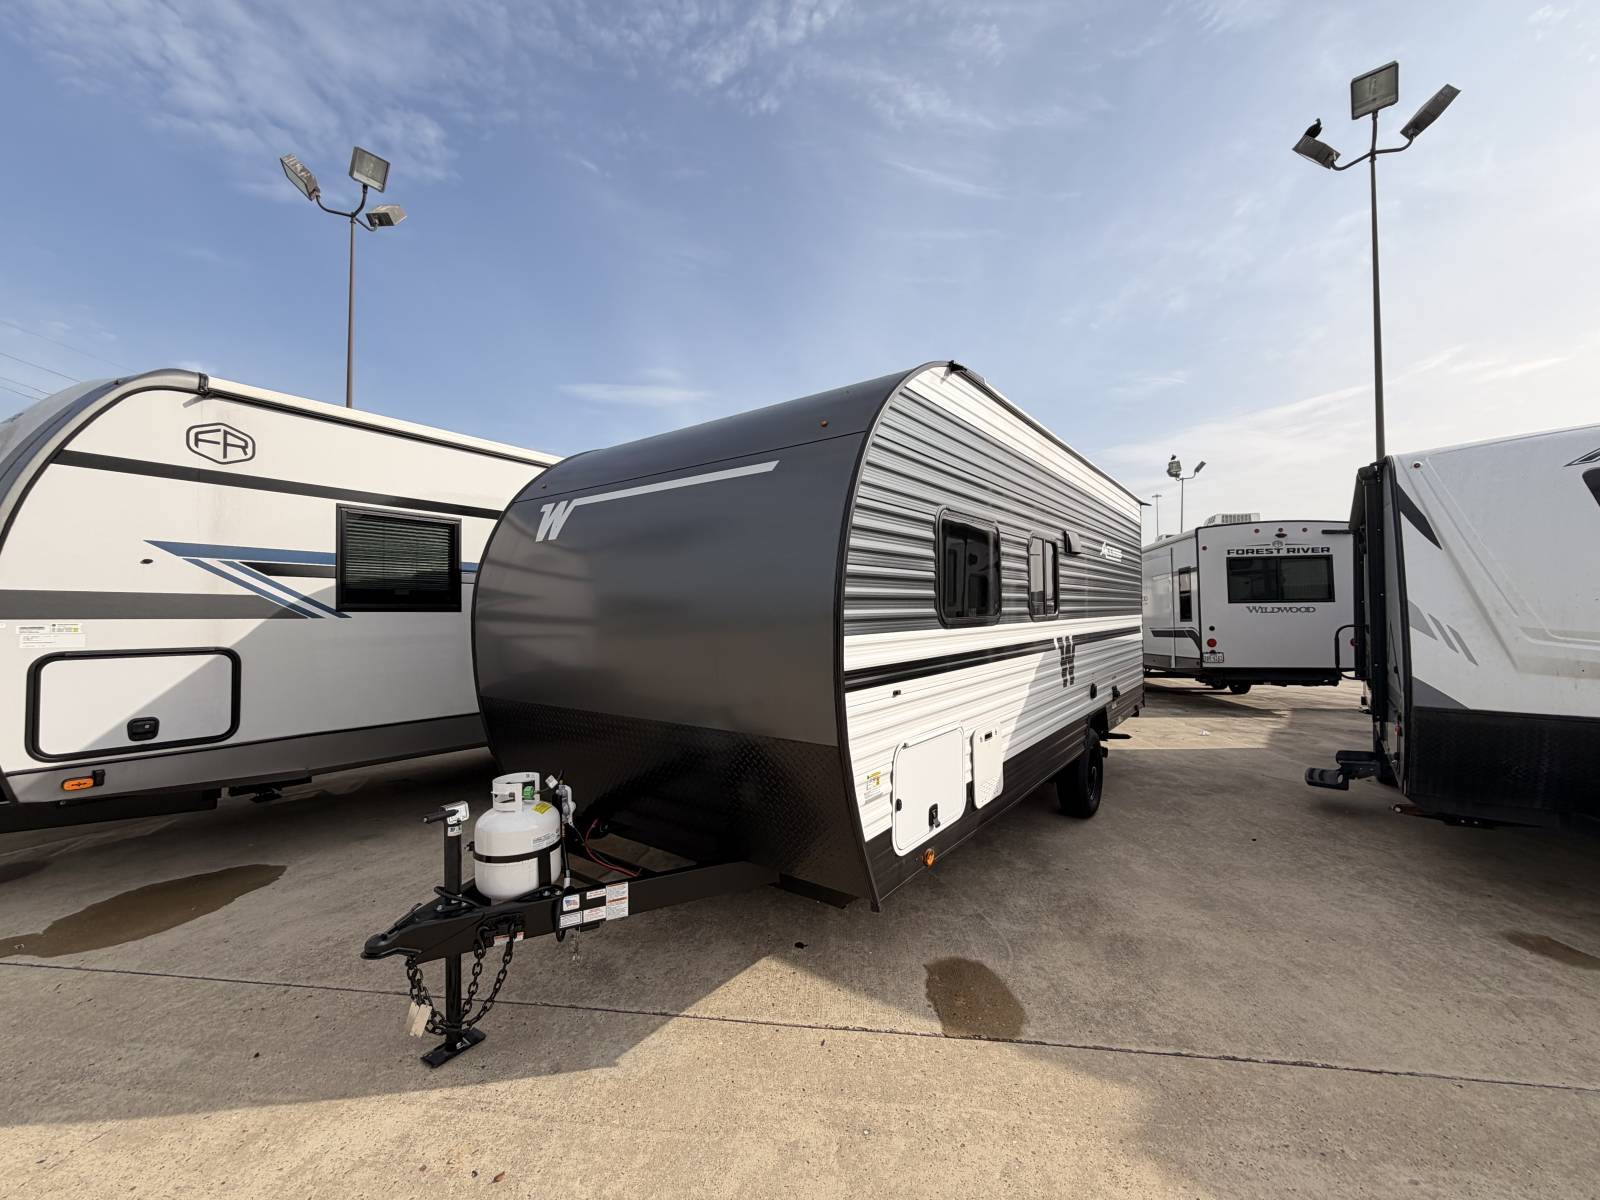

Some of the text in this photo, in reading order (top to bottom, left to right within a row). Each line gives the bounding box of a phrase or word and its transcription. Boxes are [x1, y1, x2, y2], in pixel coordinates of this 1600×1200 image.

[194, 428, 249, 459] FR
[1227, 546, 1331, 556] FOREST RIVER
[1246, 605, 1317, 614] WILDWOOD
